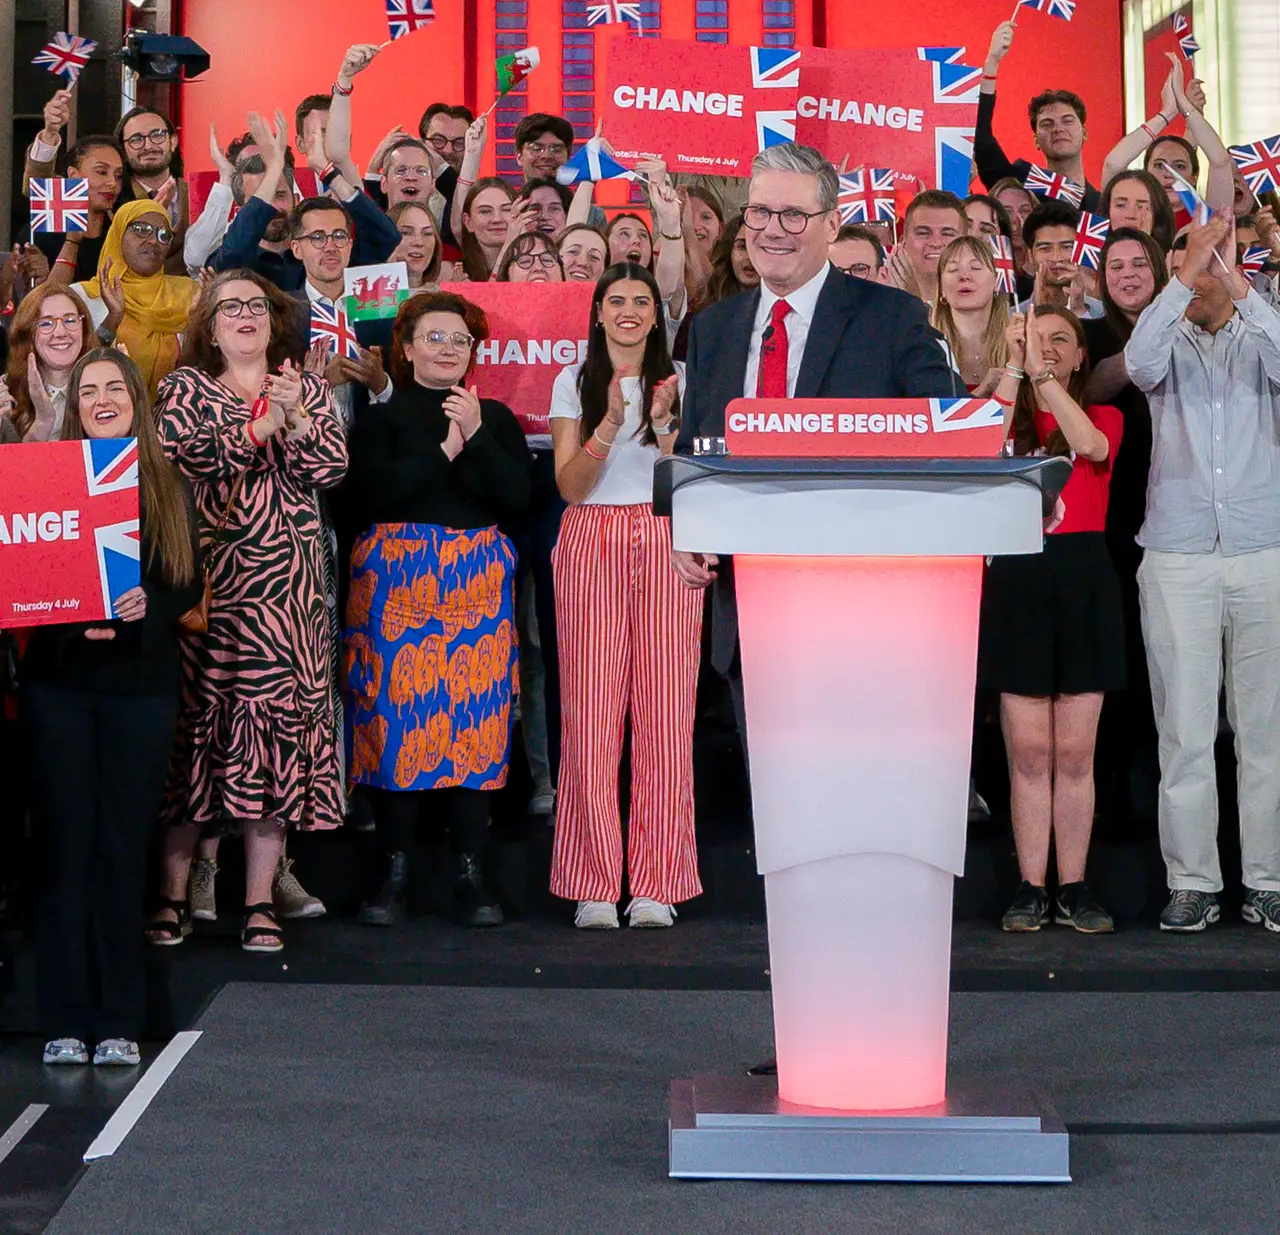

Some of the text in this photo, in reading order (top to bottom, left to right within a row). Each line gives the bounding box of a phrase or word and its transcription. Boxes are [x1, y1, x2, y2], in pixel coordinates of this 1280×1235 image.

[613, 85, 744, 118] CHANGE
[796, 95, 924, 132] CHANGE
[677, 153, 714, 166] Thursday
[714, 157, 721, 165] 4
[721, 157, 739, 168] July
[899, 172, 916, 184] July
[476, 339, 589, 365] HANGE
[728, 412, 929, 434] CHANGE BEGINS
[11, 597, 81, 613] Thursday 4 July
